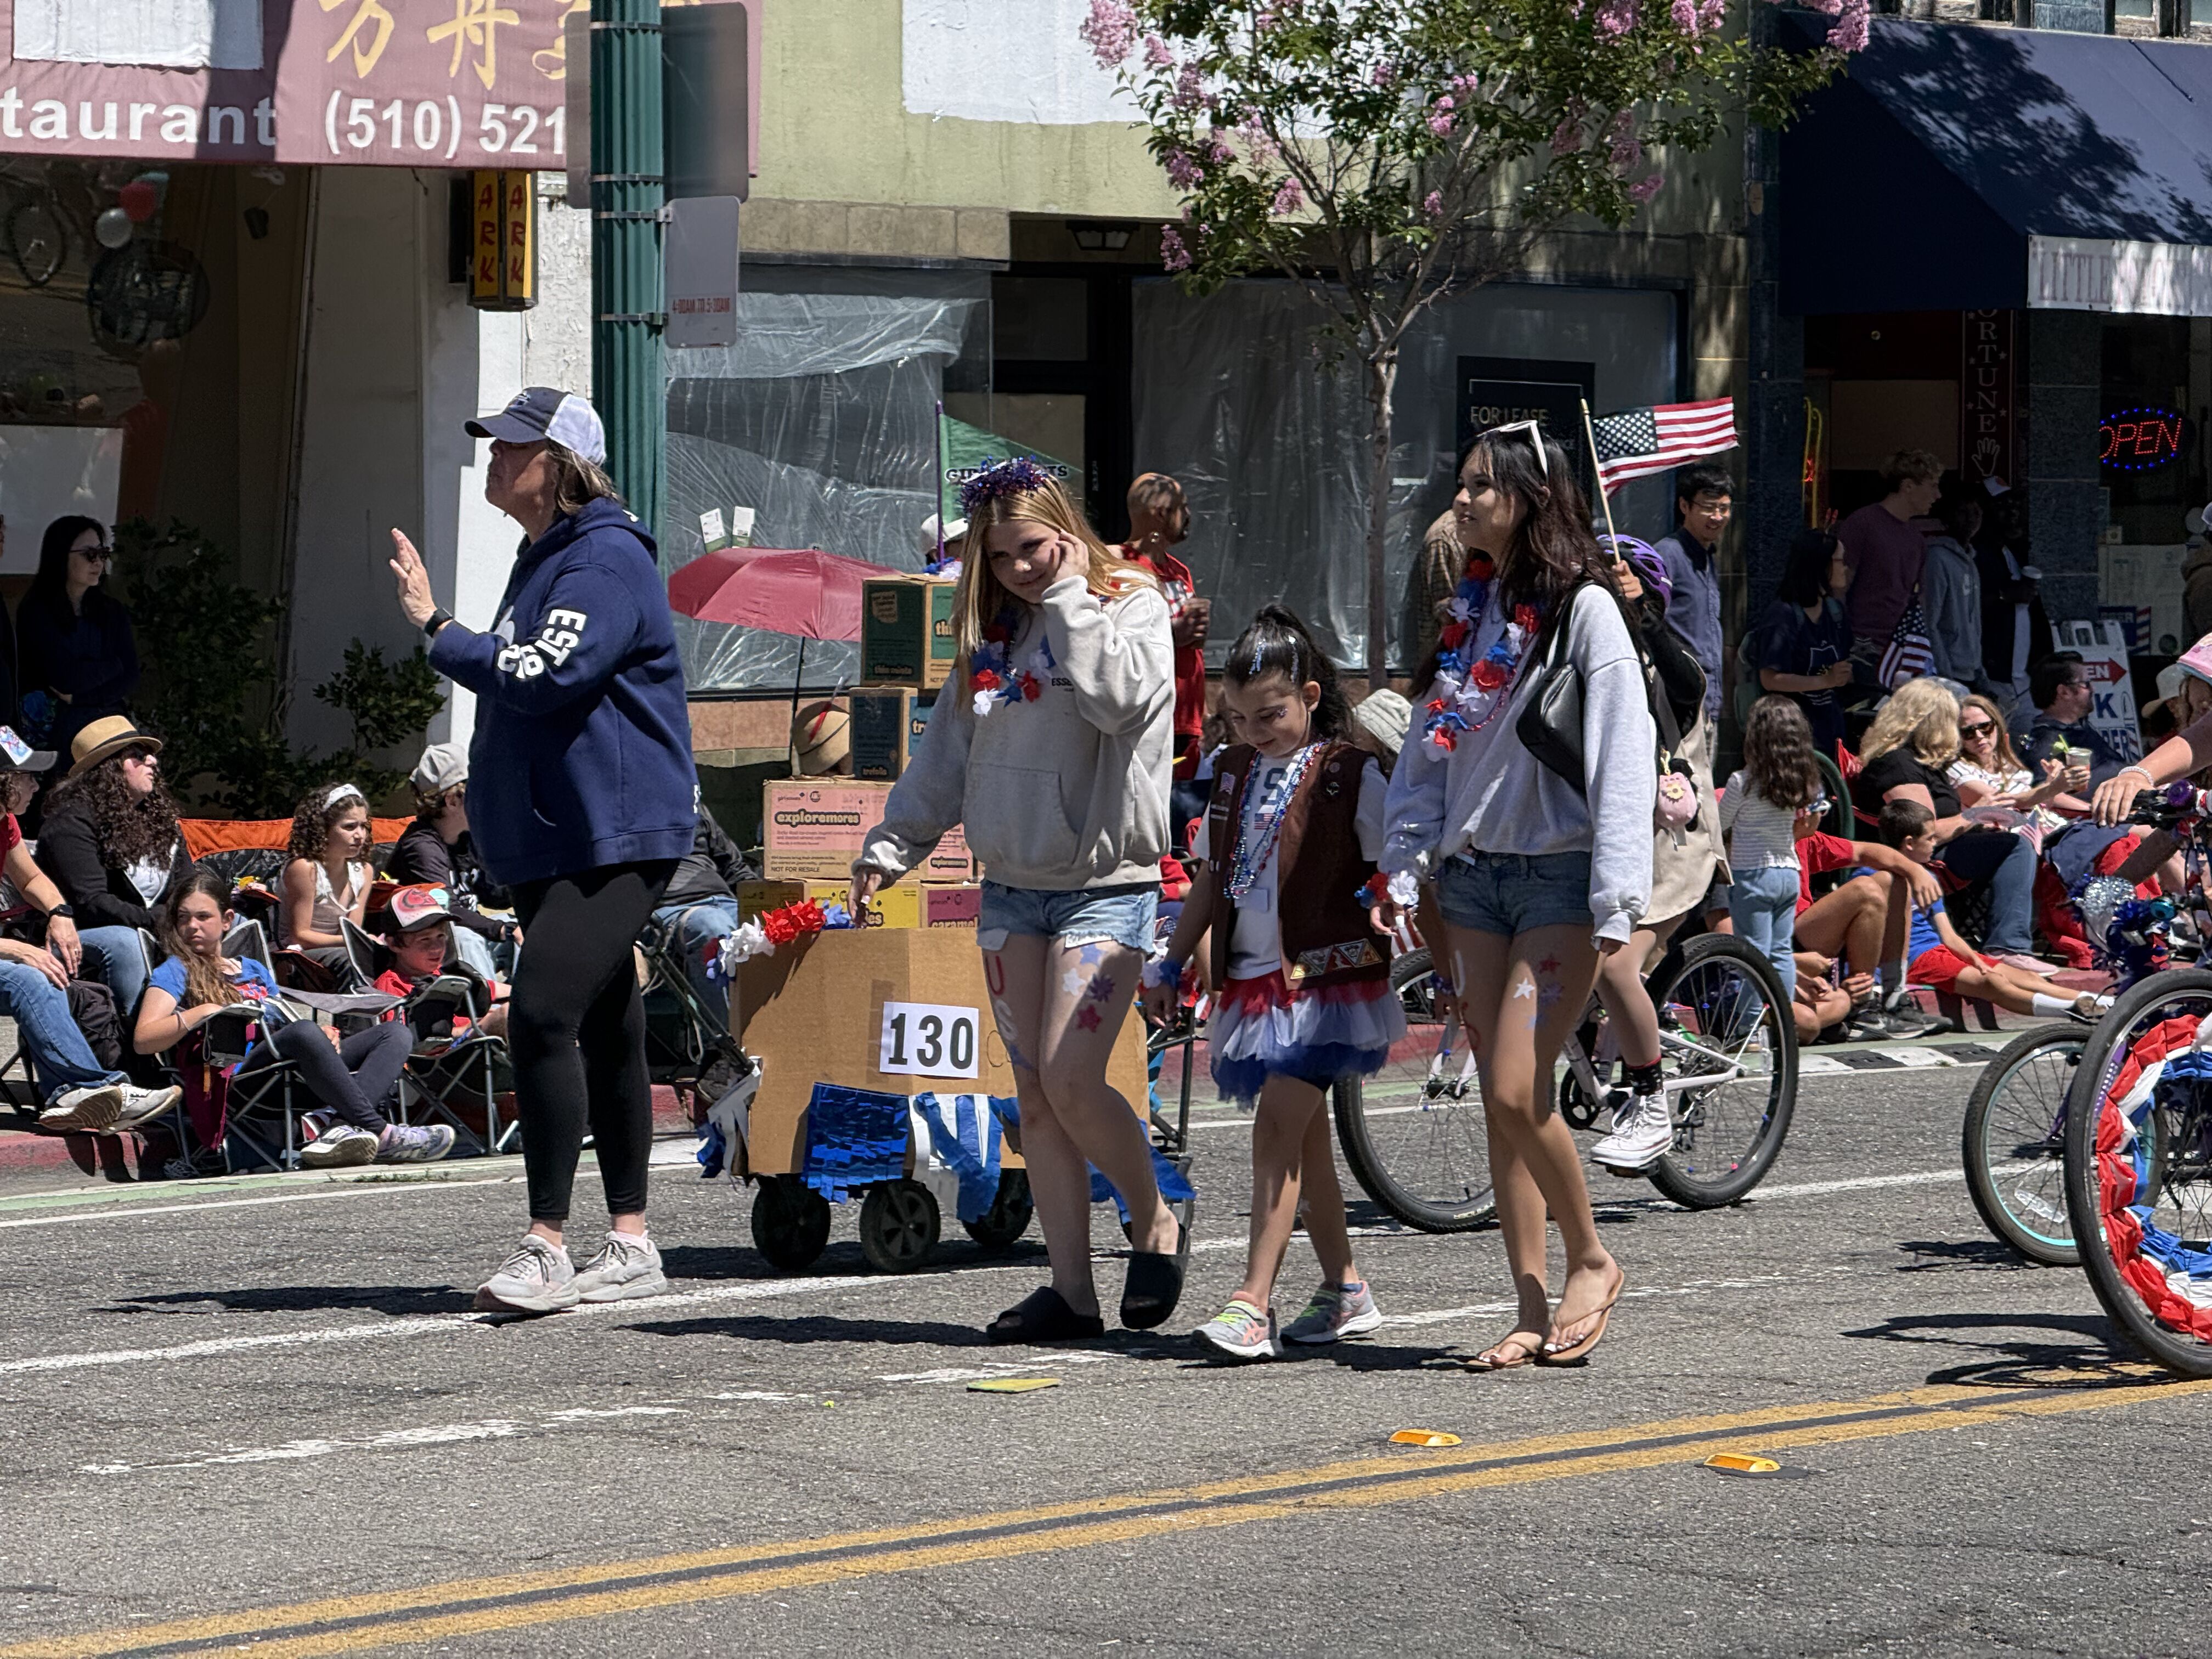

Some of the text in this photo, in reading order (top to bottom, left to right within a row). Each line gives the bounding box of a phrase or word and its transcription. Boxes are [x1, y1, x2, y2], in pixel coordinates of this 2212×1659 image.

[0, 86, 276, 146] taurant
[325, 90, 565, 159] (510) 521
[478, 184, 495, 283] ARK
[1471, 406, 1499, 425] FOR
[534, 610, 586, 667] EST
[776, 810, 859, 825] exploremores
[888, 1013, 973, 1070] 130
